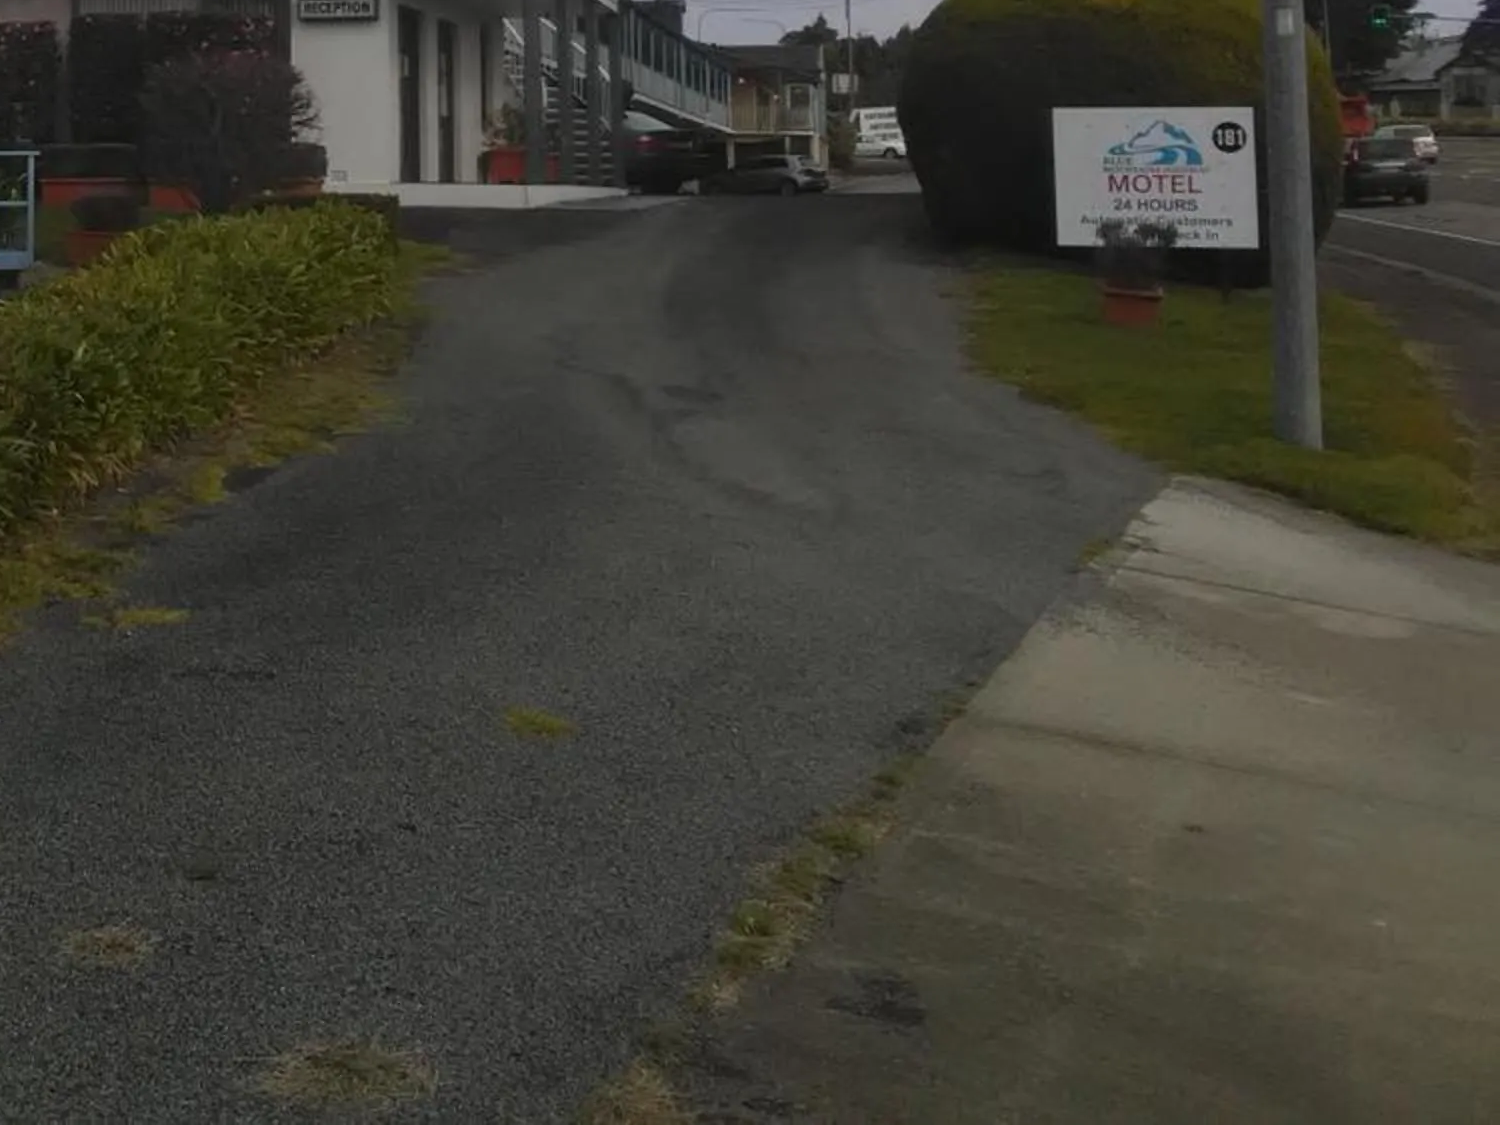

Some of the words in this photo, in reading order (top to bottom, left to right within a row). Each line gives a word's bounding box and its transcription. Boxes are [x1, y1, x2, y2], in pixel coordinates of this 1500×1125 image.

[303, 2, 371, 14] RECEPTION
[1217, 128, 1244, 146] 181
[1108, 174, 1203, 193] MOTEL
[1113, 199, 1132, 211] 24
[1138, 198, 1199, 211] HOURS
